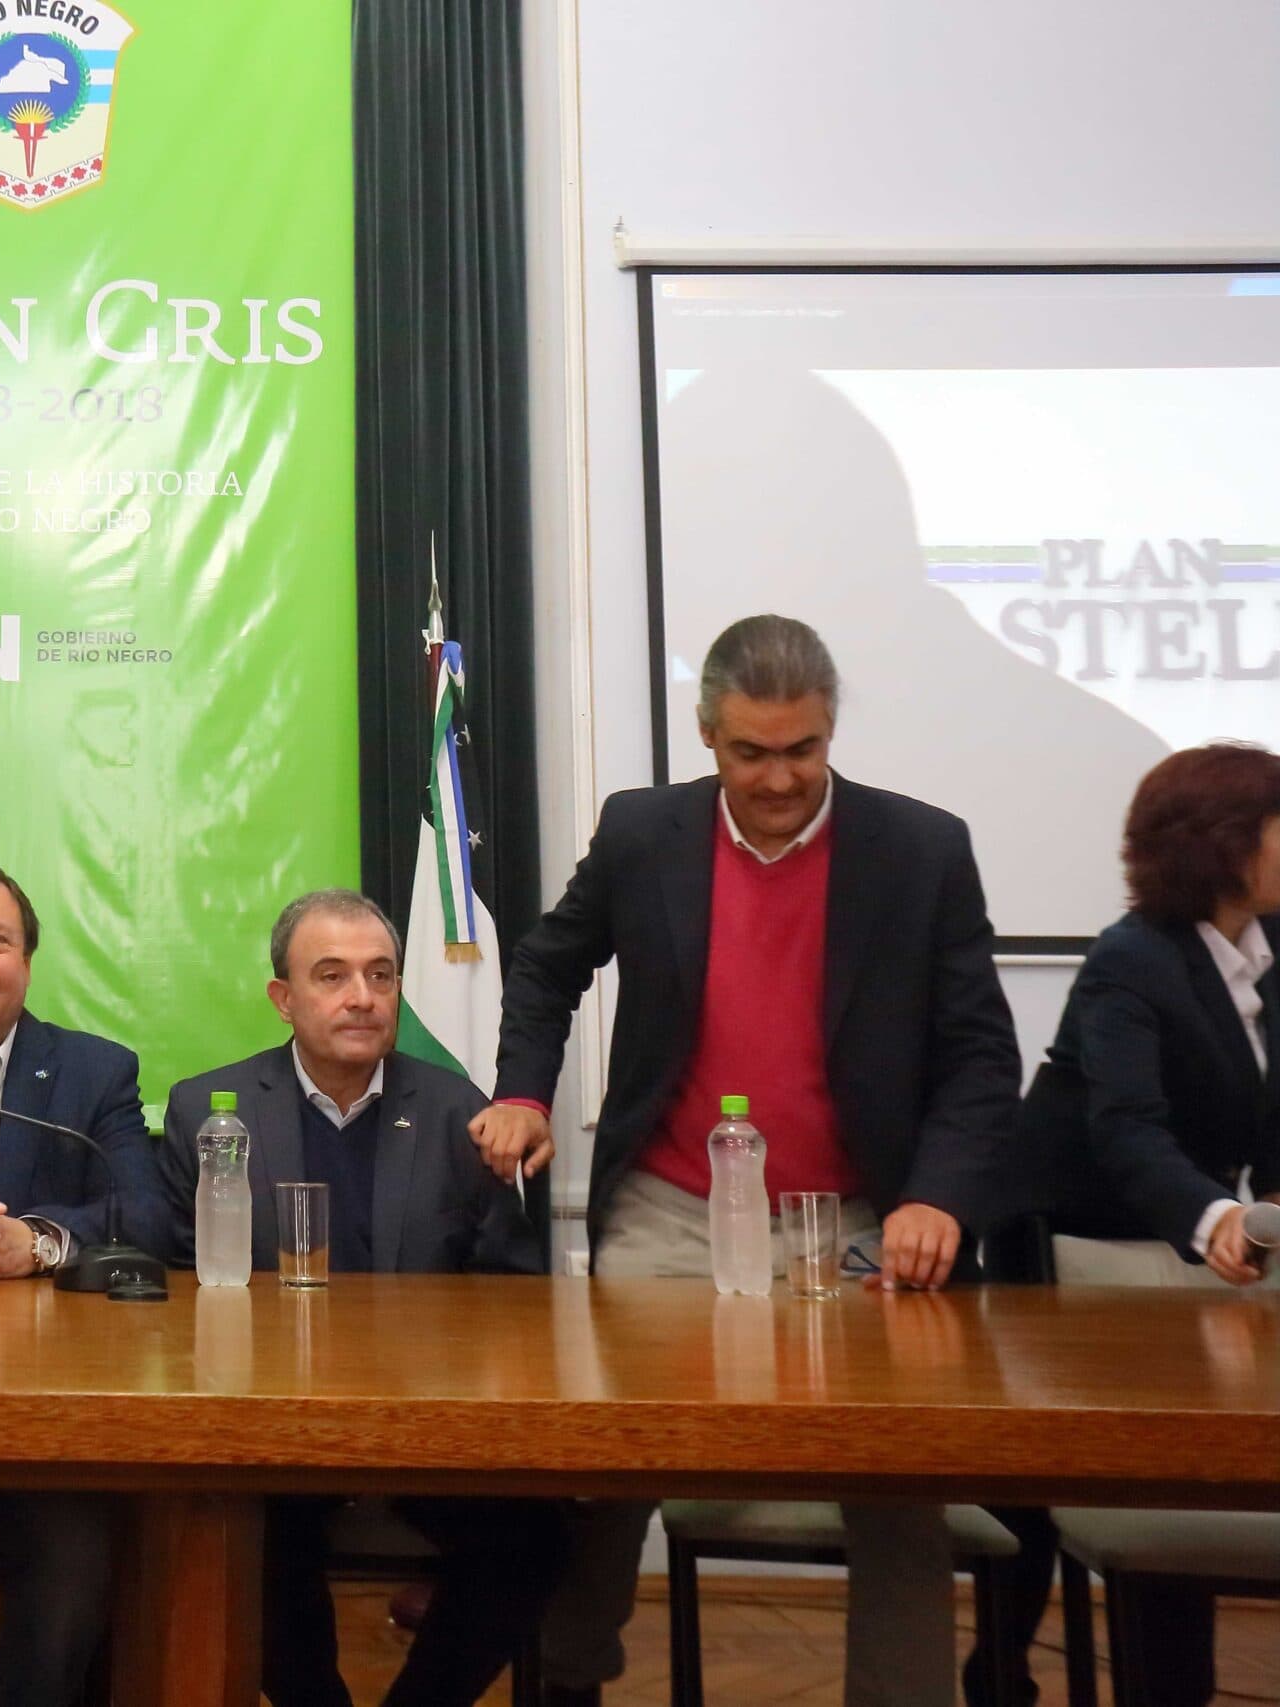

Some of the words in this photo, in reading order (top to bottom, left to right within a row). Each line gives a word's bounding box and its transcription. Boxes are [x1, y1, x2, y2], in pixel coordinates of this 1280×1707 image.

[16, 0, 100, 36] NEGRO
[85, 279, 323, 366] GRIS
[23, 470, 66, 495] LA
[78, 469, 244, 497] HISTORIA
[32, 508, 152, 534] NEGRO
[1042, 538, 1223, 588] PLAN
[37, 630, 137, 645] GOBIERNO
[999, 598, 1280, 681] STEL
[37, 649, 61, 663] DE
[107, 649, 173, 663] NEGRO
